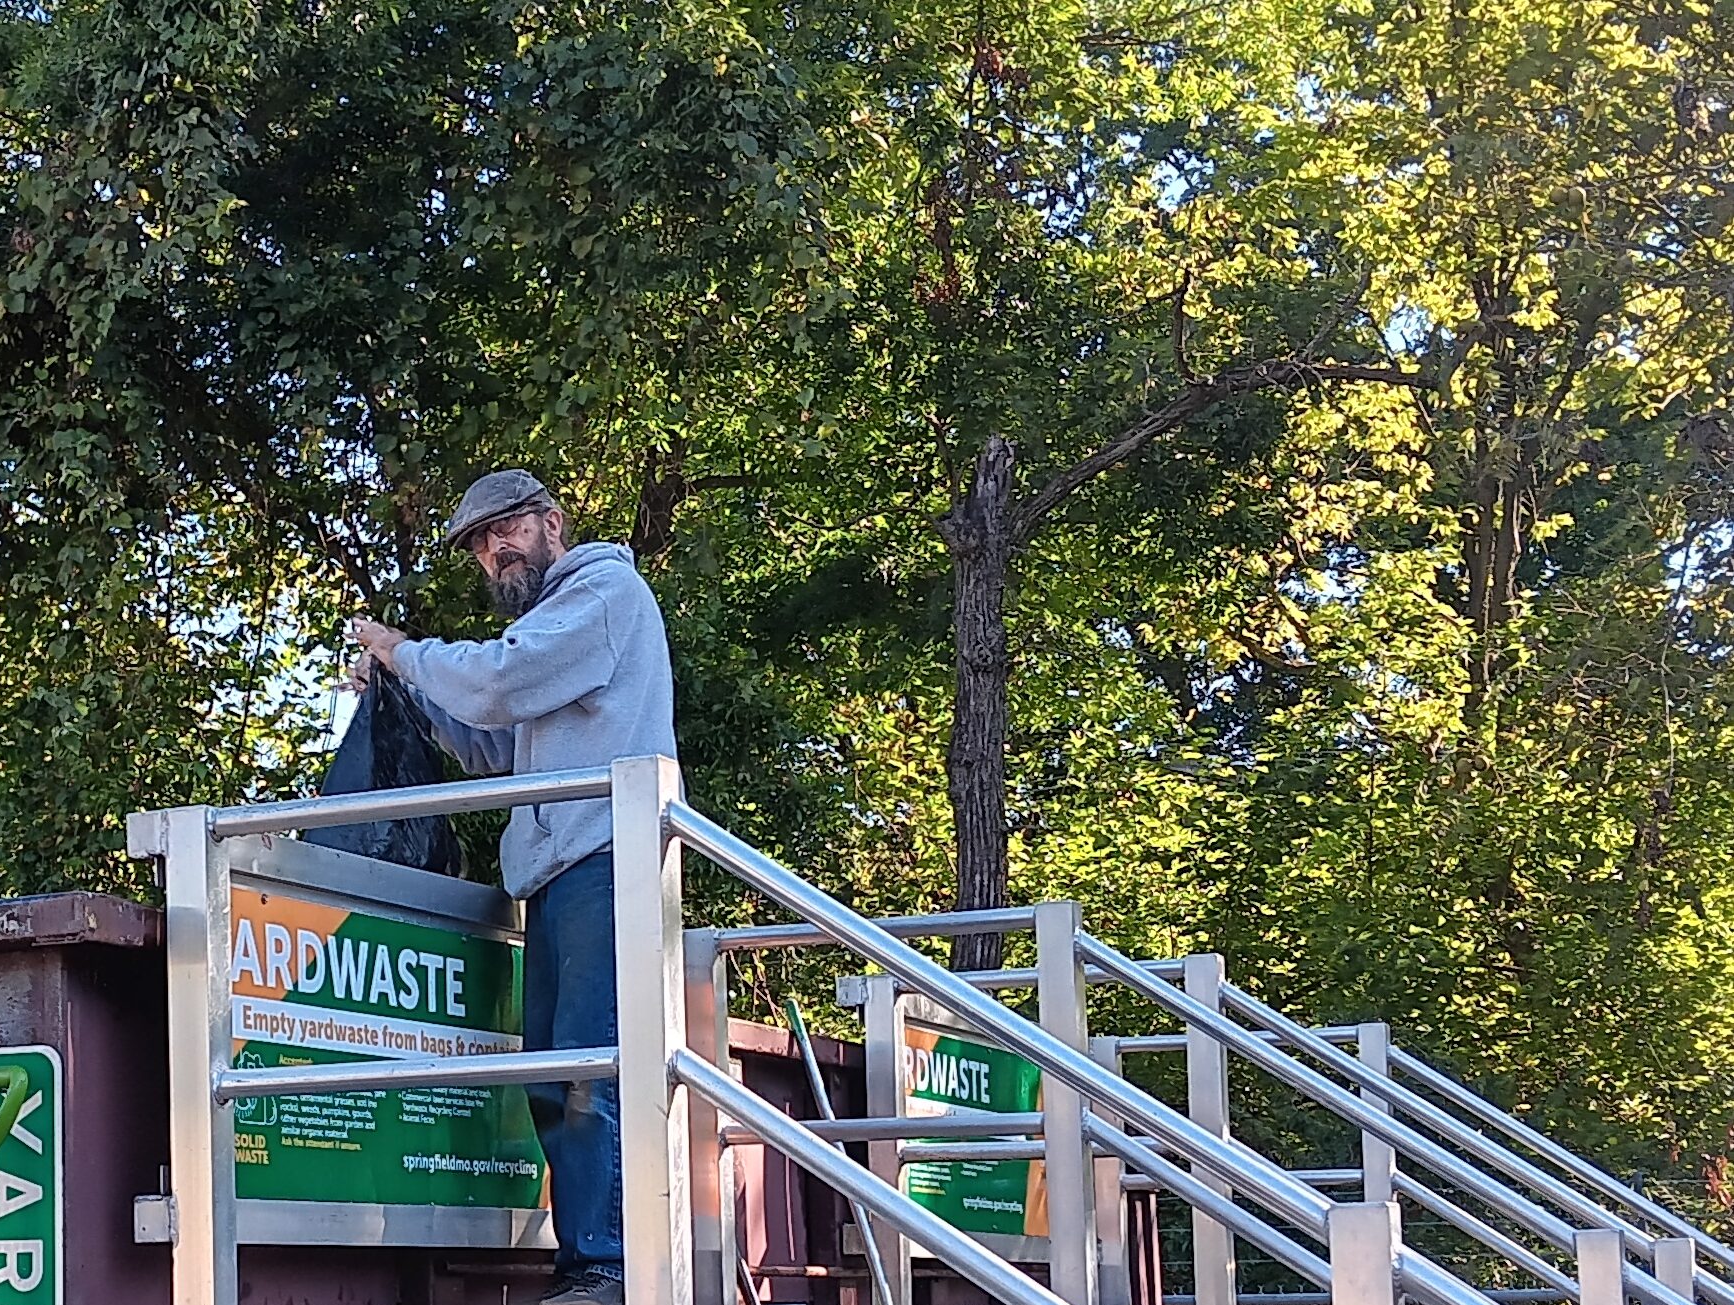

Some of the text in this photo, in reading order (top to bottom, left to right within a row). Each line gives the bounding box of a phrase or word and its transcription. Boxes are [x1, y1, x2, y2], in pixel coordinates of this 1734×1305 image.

[243, 1005, 295, 1040] Empty
[299, 1018, 378, 1046] yardwaste
[382, 1025, 417, 1051] from
[420, 1030, 452, 1057] bags
[234, 1133, 266, 1148] SOLID
[234, 1148, 269, 1164] WASTE
[403, 1152, 538, 1180] springfieldmo.gov/recycling
